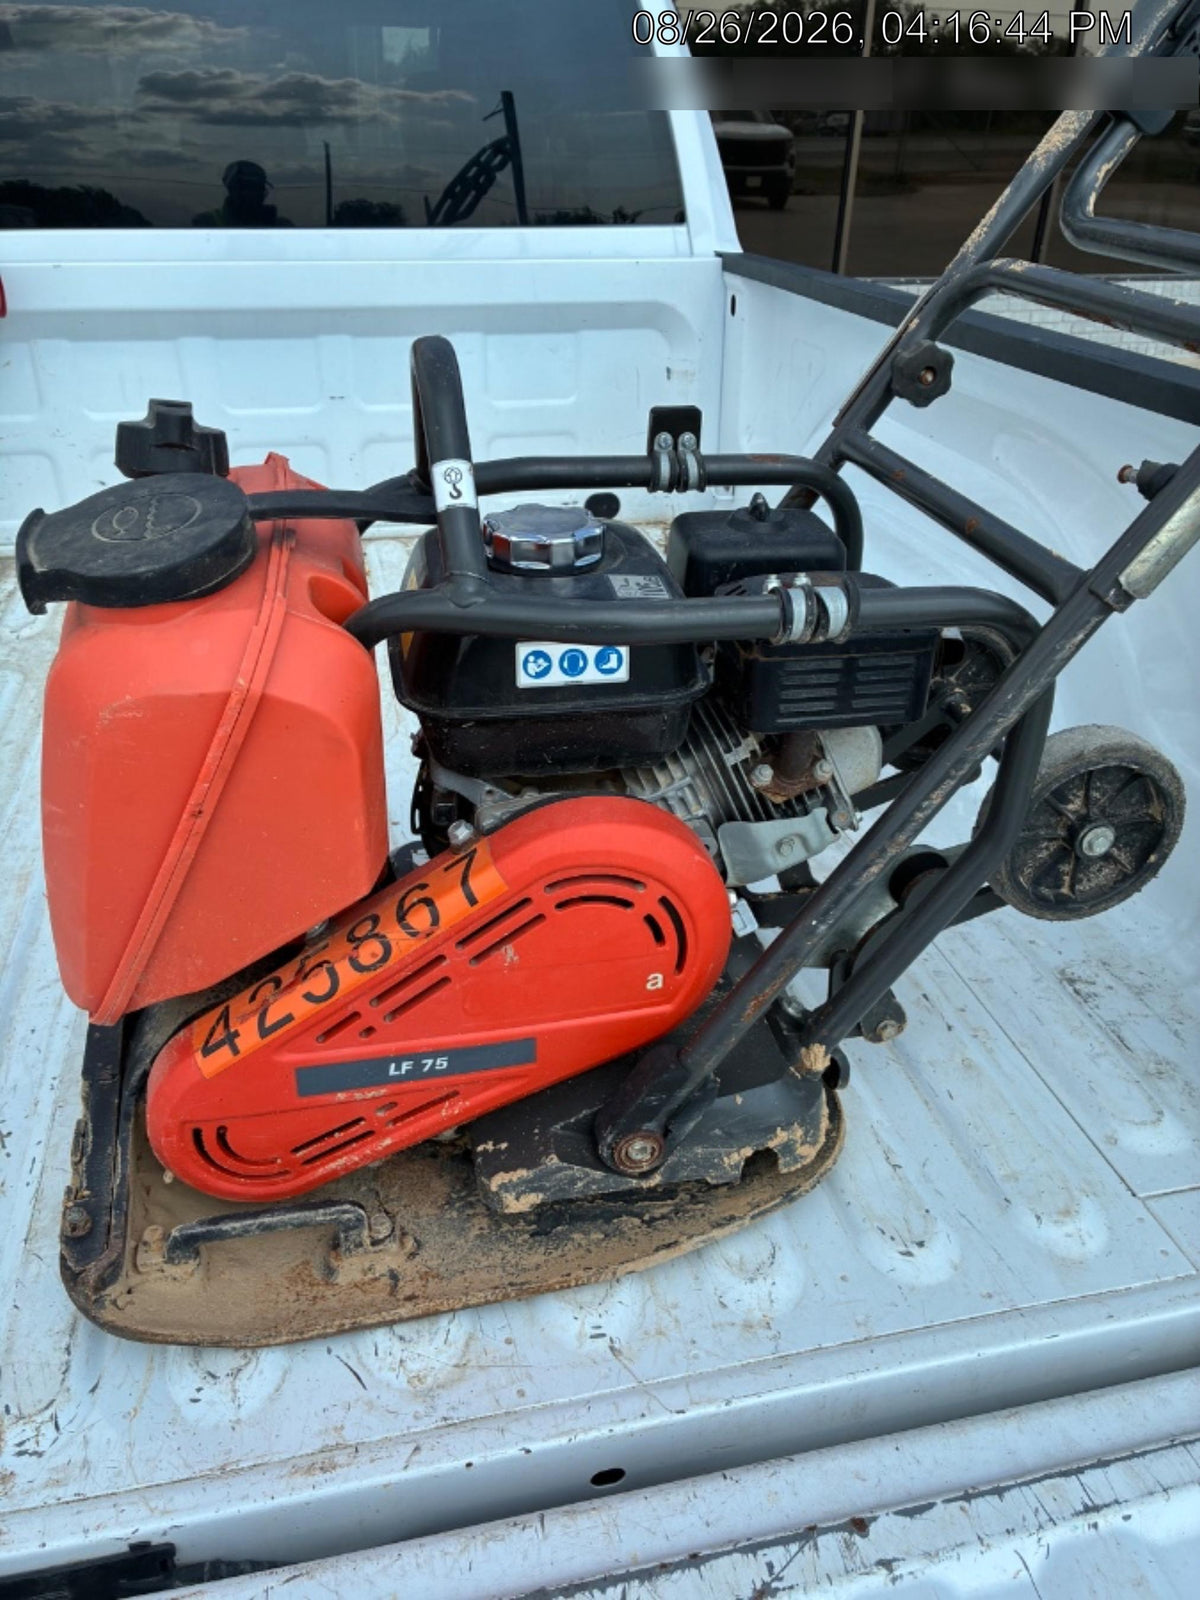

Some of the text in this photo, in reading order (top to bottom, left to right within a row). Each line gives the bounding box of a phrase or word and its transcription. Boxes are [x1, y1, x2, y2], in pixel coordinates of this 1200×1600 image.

[200, 848, 479, 1058] 425867
[388, 1056, 449, 1077] LF 75
